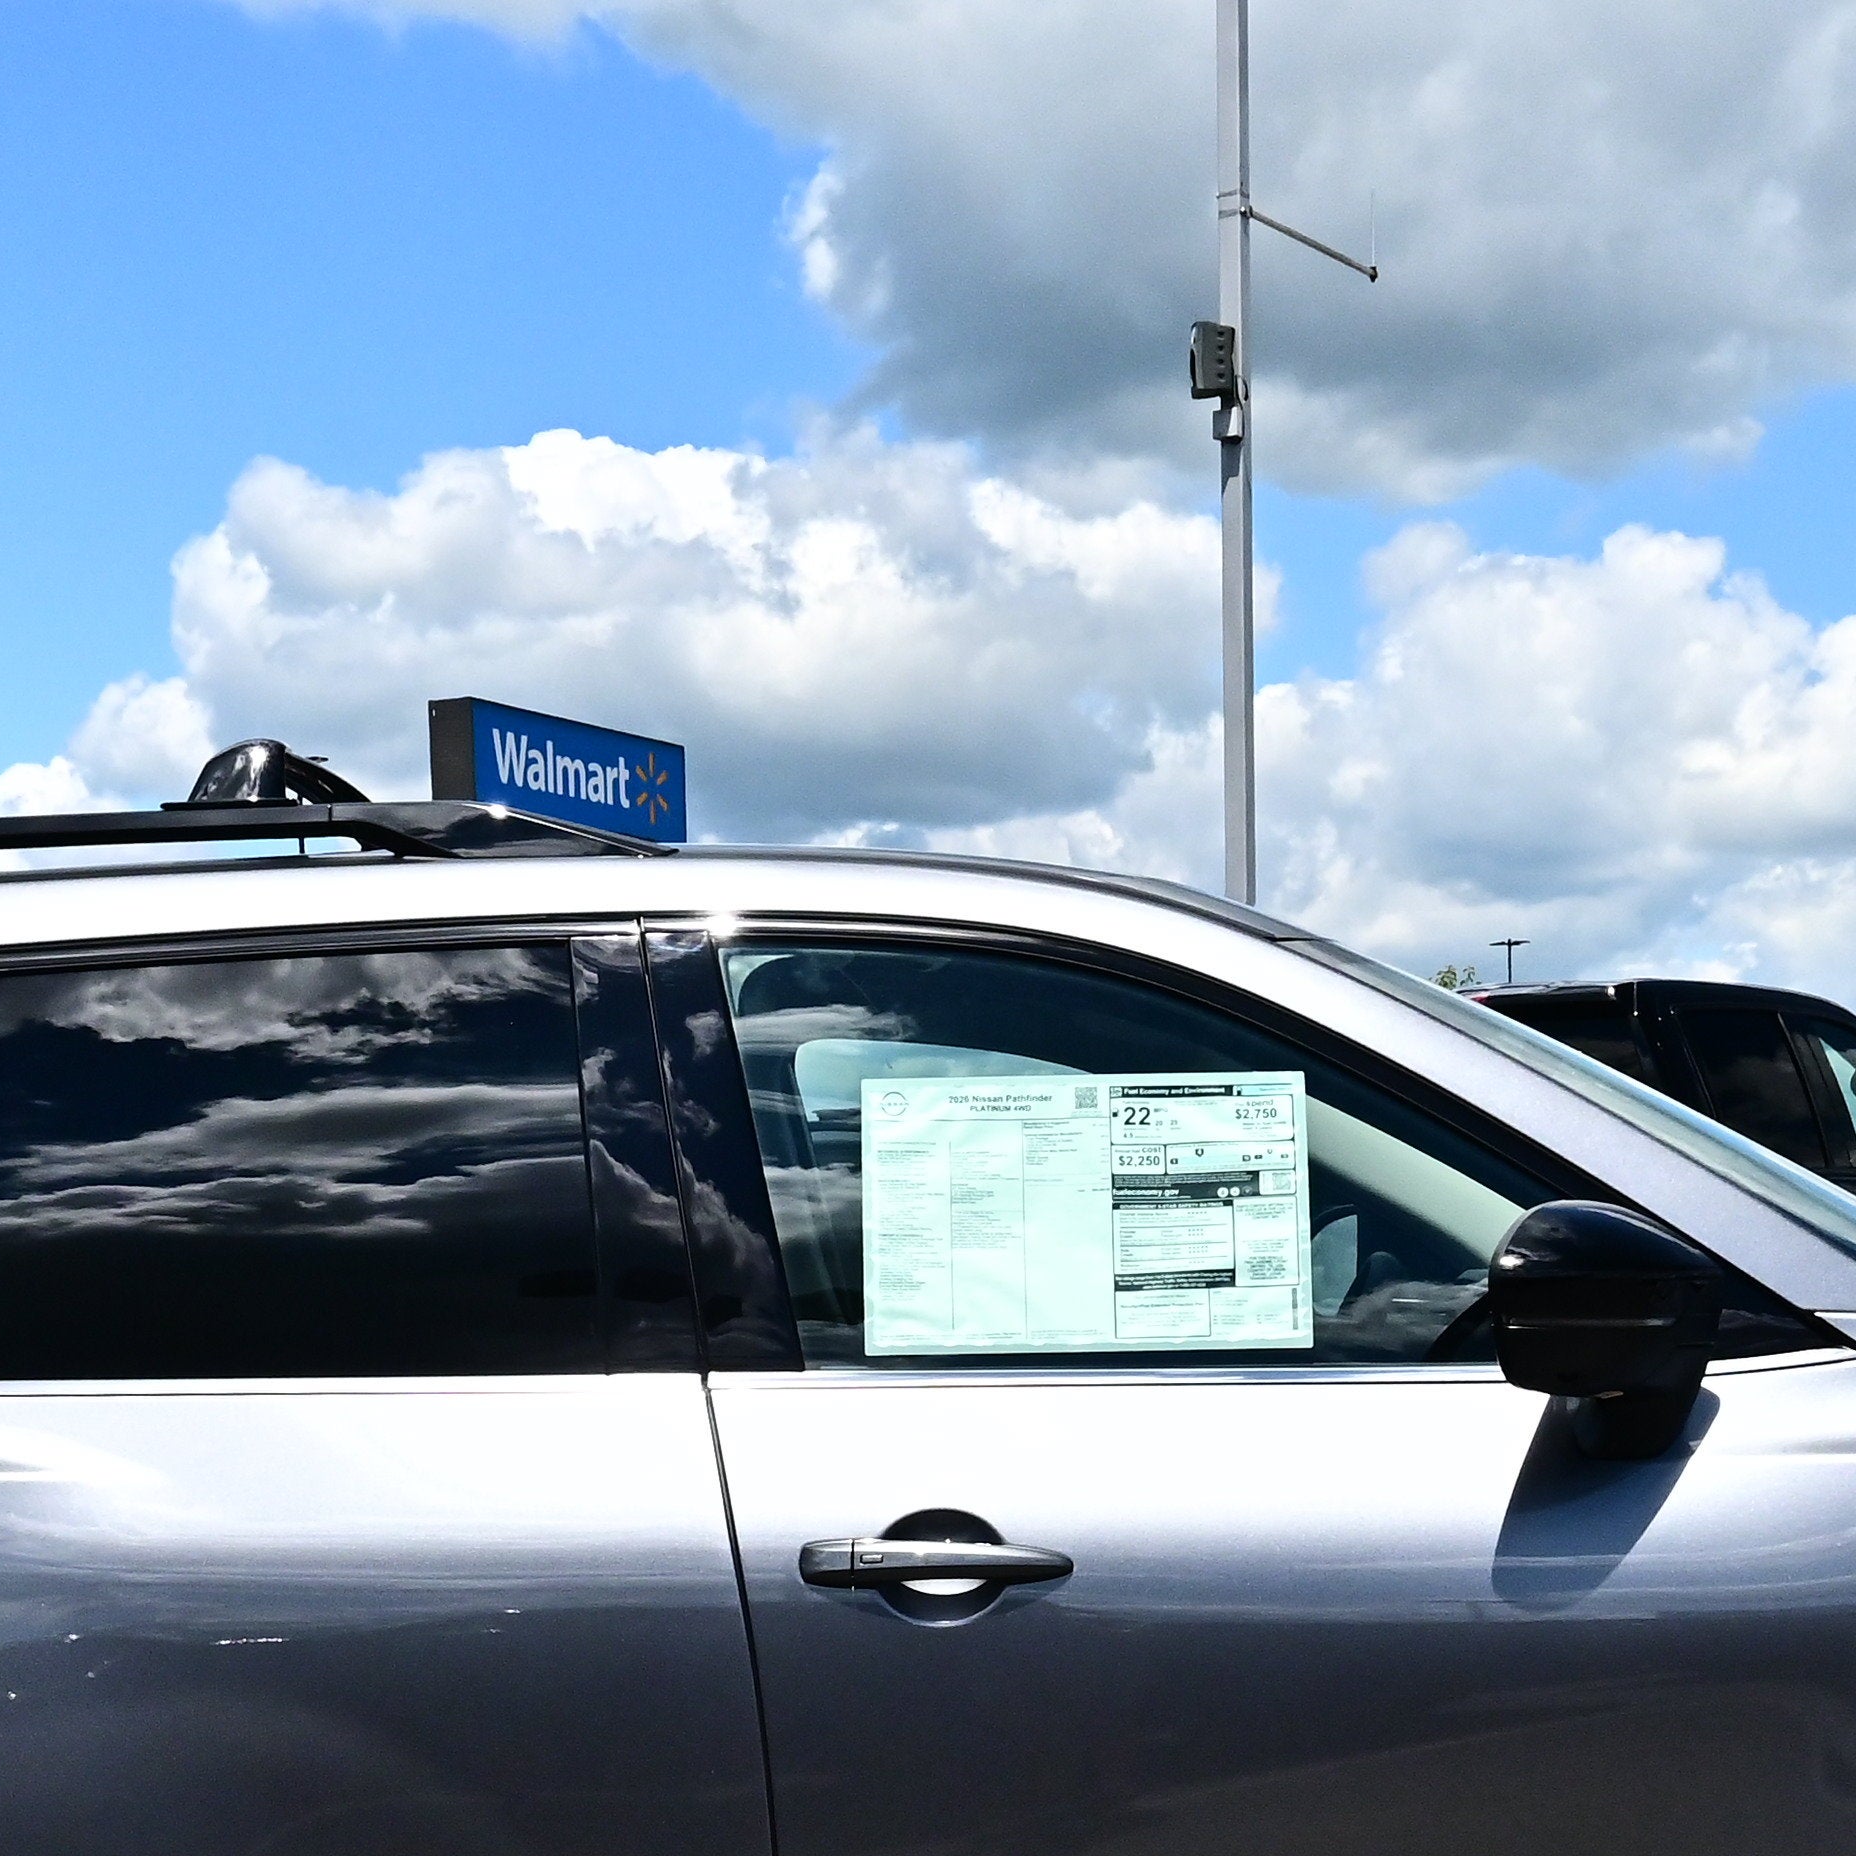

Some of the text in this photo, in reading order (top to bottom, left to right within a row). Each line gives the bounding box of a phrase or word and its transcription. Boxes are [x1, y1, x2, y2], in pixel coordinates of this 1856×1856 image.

[492, 727, 630, 808] Walmart
[972, 1095, 1003, 1103] Nissan
[1005, 1094, 1052, 1103] Pathfinder
[1124, 1106, 1151, 1125] 22
[1235, 1107, 1277, 1120] $2,750
[1119, 1155, 1160, 1167] $2,250
